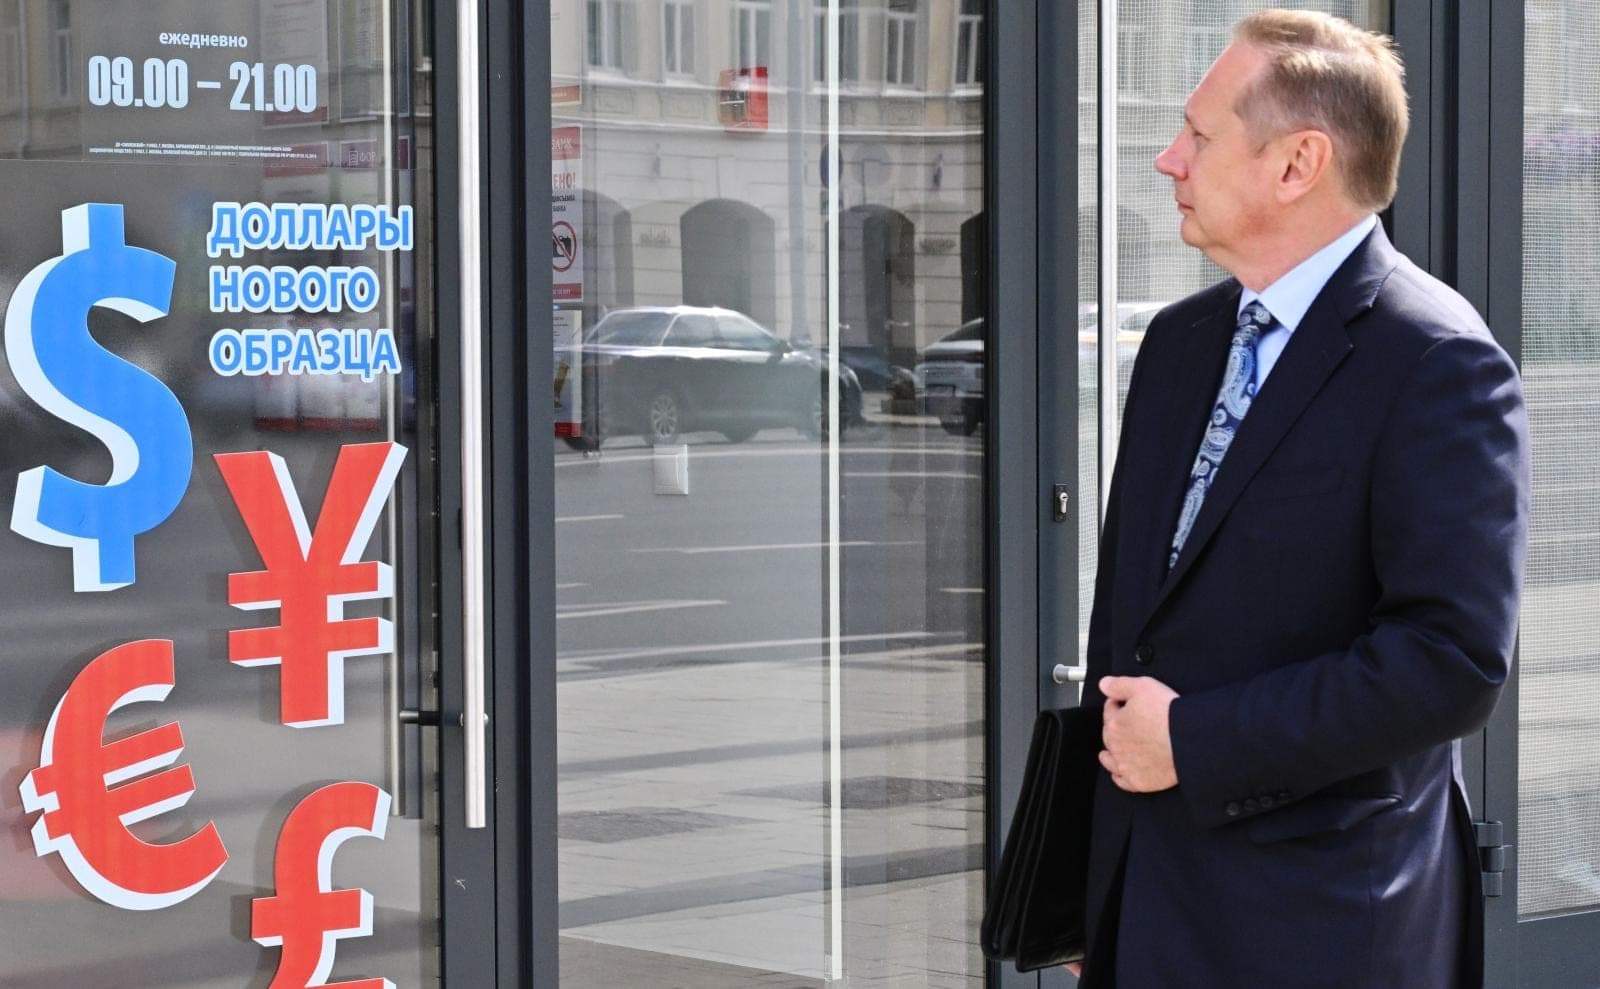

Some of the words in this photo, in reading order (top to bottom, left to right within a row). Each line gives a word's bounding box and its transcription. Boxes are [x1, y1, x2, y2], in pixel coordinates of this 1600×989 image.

[159, 31, 248, 48] ежедневно
[88, 56, 188, 108] 09.00
[229, 62, 317, 113] 21.00
[207, 202, 413, 257] ДОЛЛАРЫ
[208, 266, 380, 313] НОВОГО
[208, 328, 402, 382] ОБРАЗЦА
